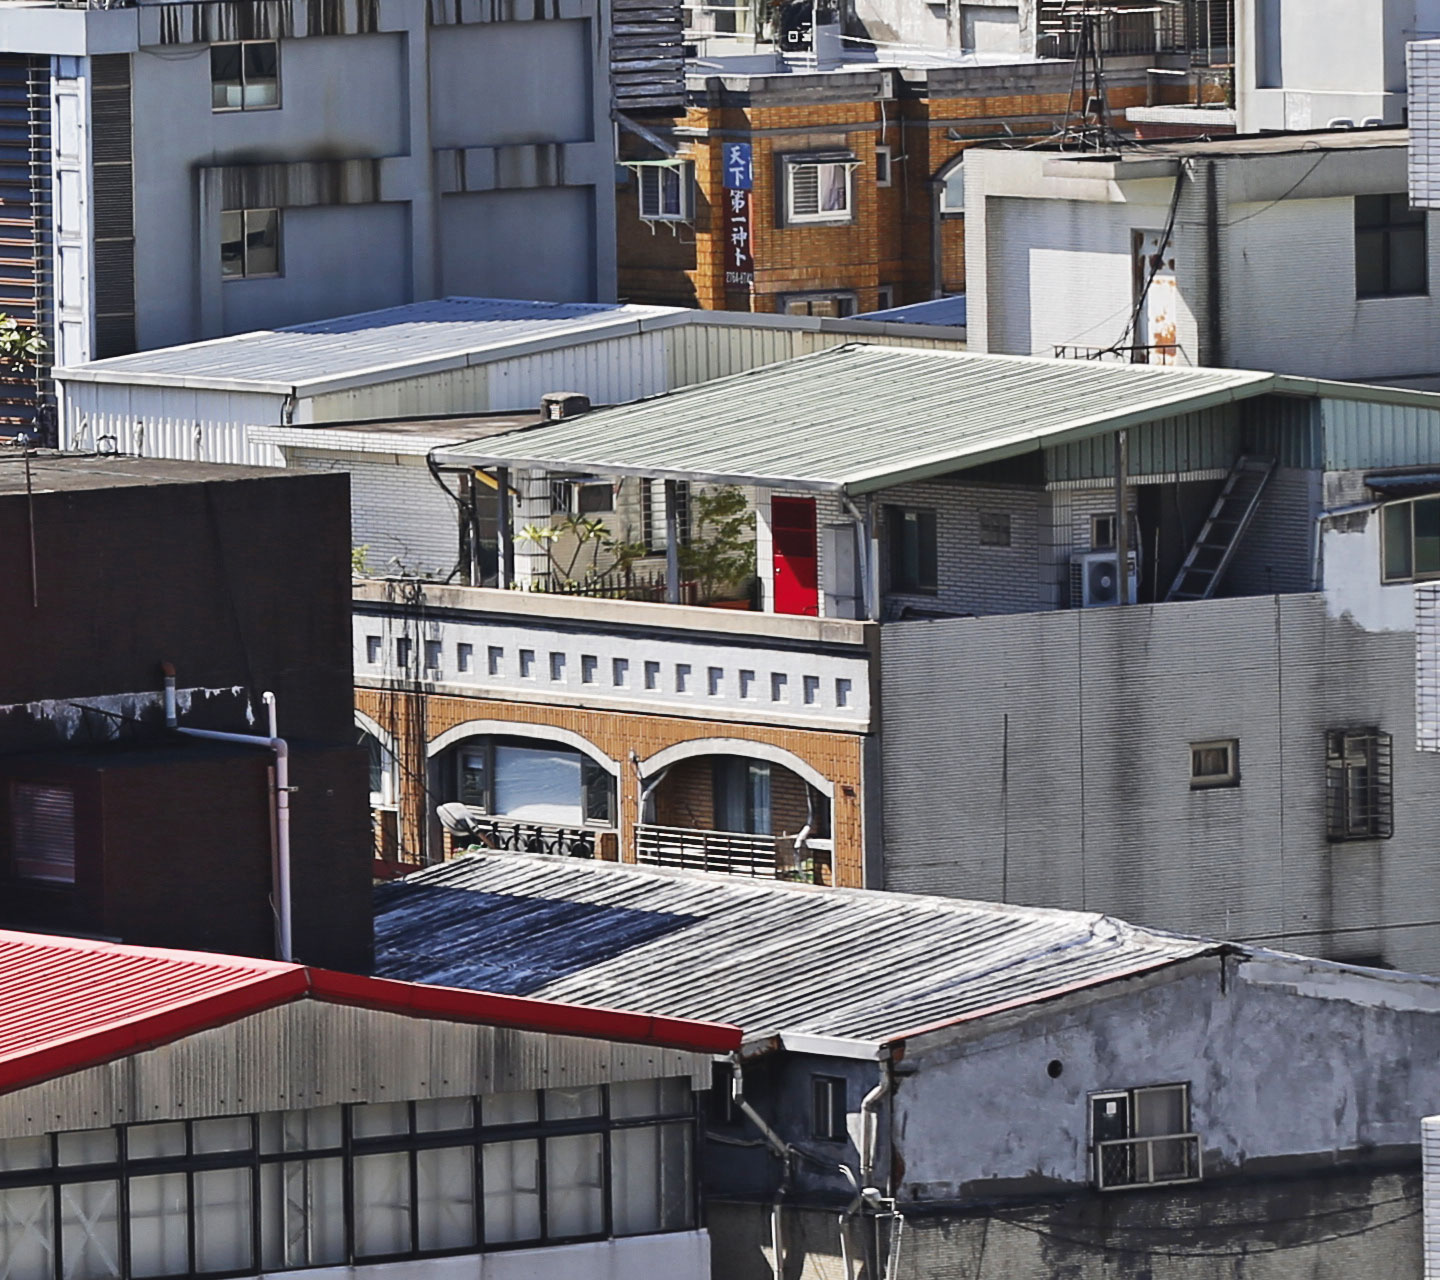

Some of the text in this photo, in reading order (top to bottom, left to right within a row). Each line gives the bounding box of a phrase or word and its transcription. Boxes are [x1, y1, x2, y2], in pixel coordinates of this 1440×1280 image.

[729, 145, 748, 267] 天下第一神卜
